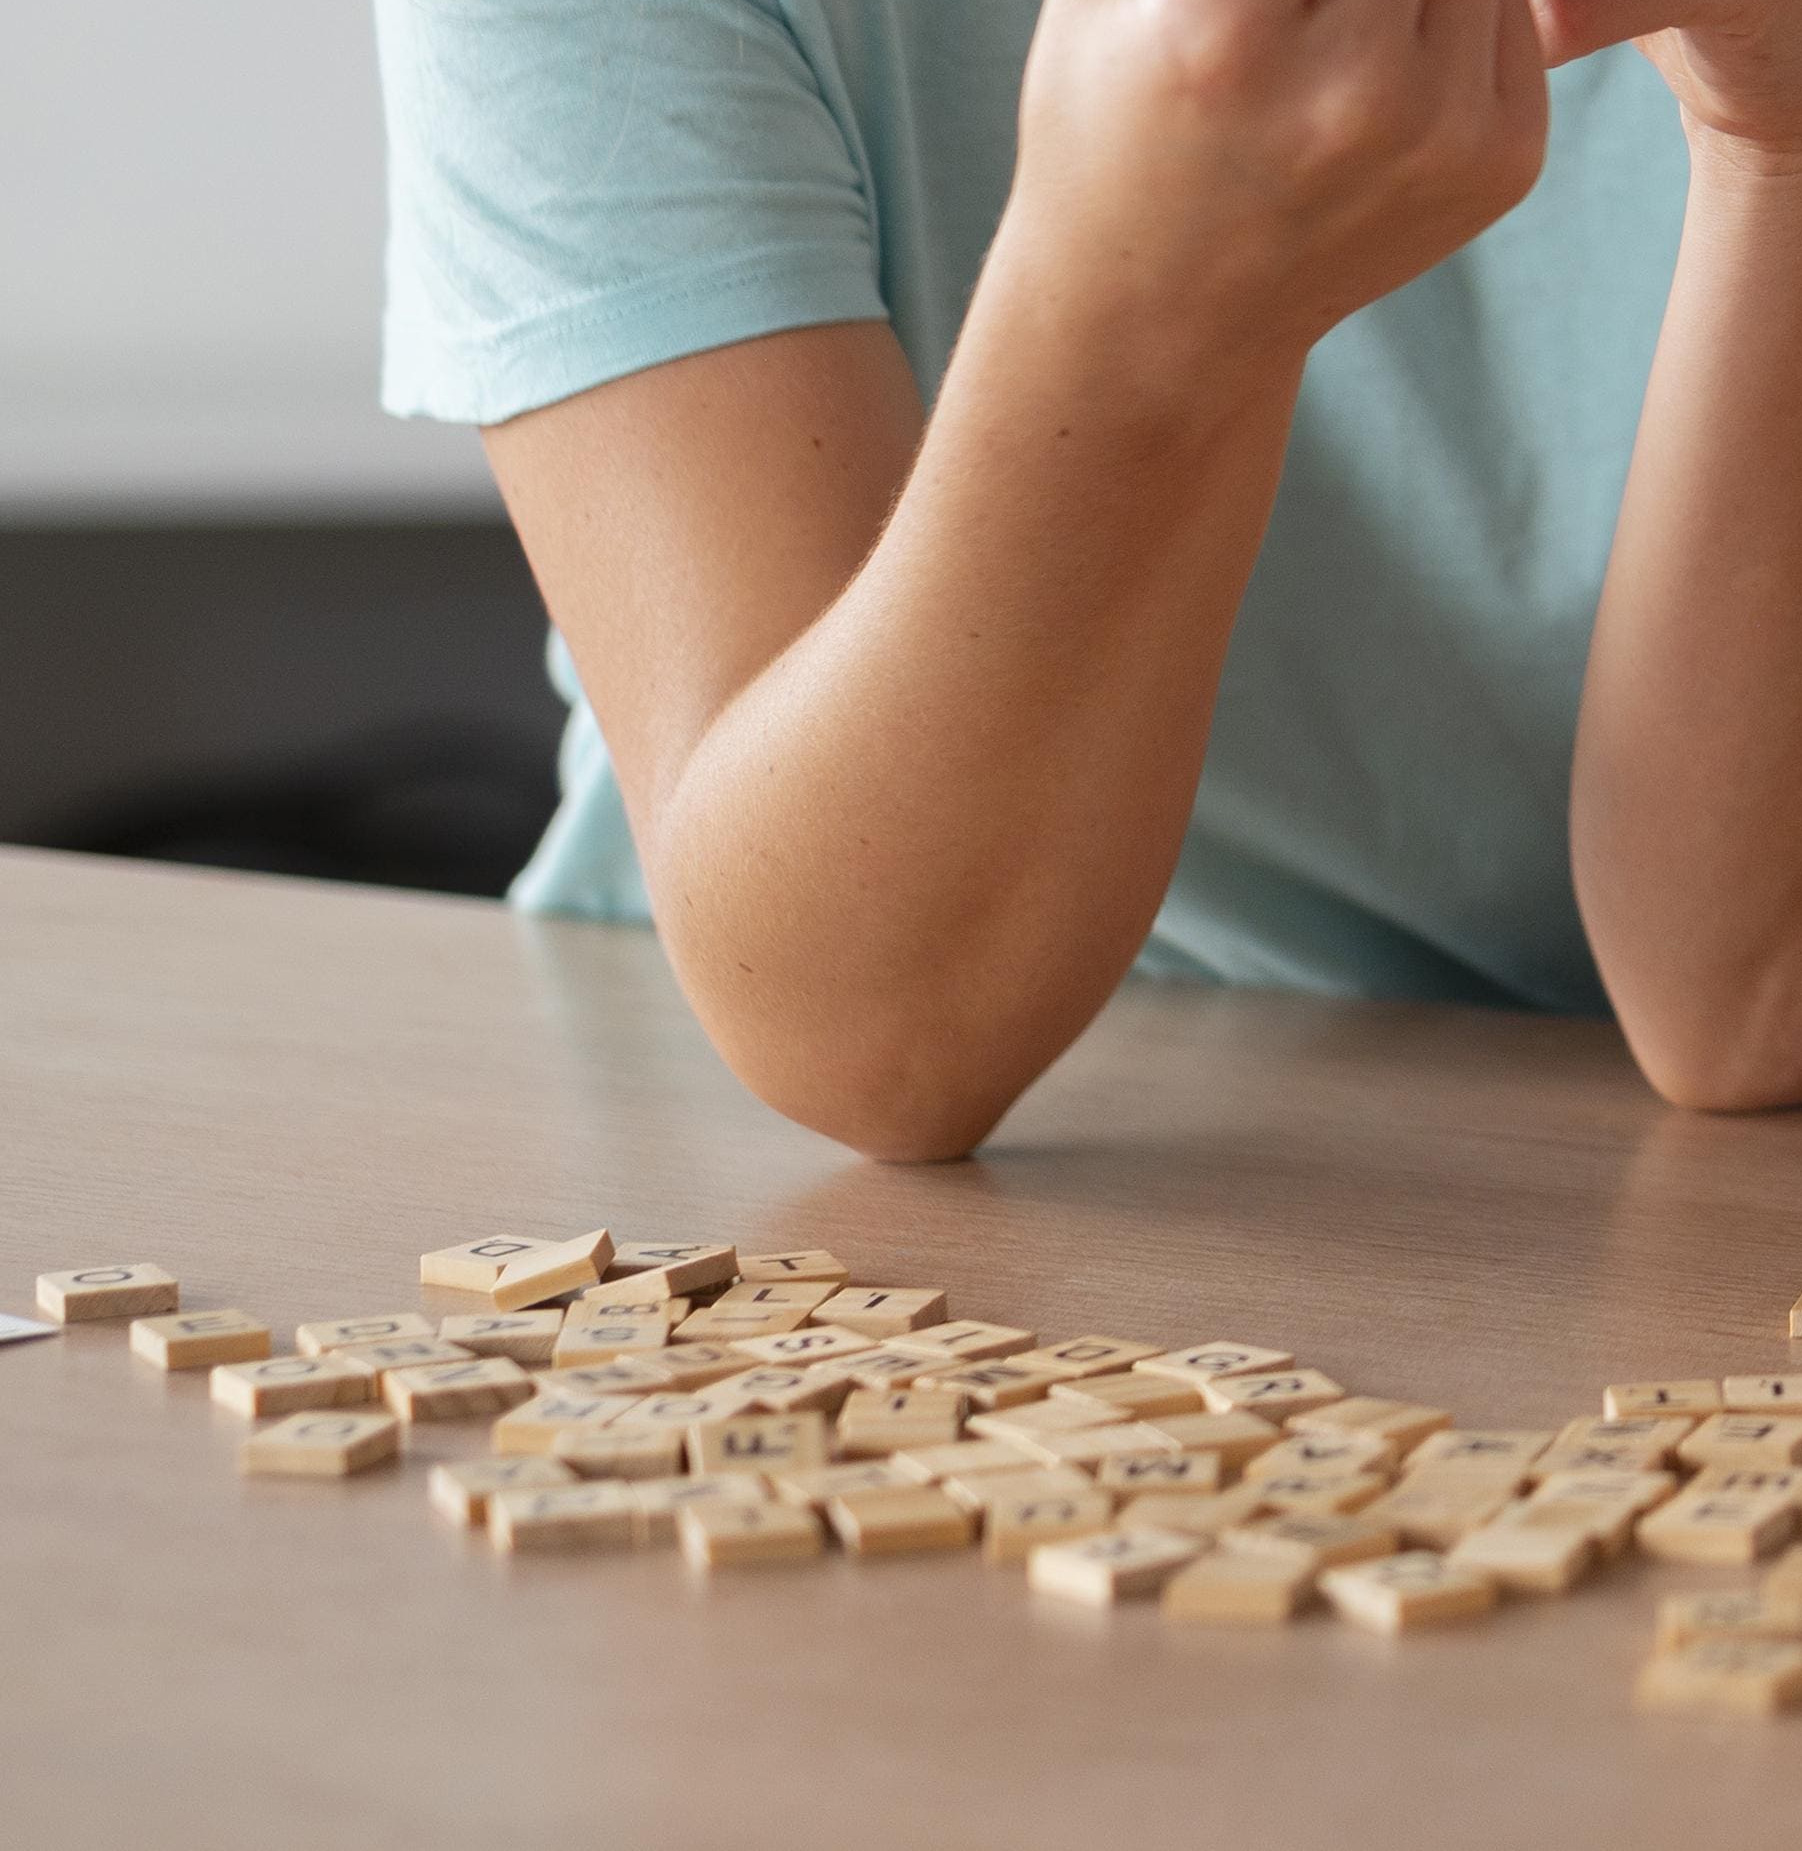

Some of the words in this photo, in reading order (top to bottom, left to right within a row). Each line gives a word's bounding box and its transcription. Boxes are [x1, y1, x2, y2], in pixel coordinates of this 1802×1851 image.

[469, 1243, 533, 1258] D
[638, 1246, 700, 1260] A
[759, 1257, 807, 1271] T
[72, 1271, 134, 1284] O
[752, 1288, 791, 1303] L
[599, 1304, 659, 1316] B
[774, 1335, 835, 1353] S
[1056, 1344, 1116, 1361] O
